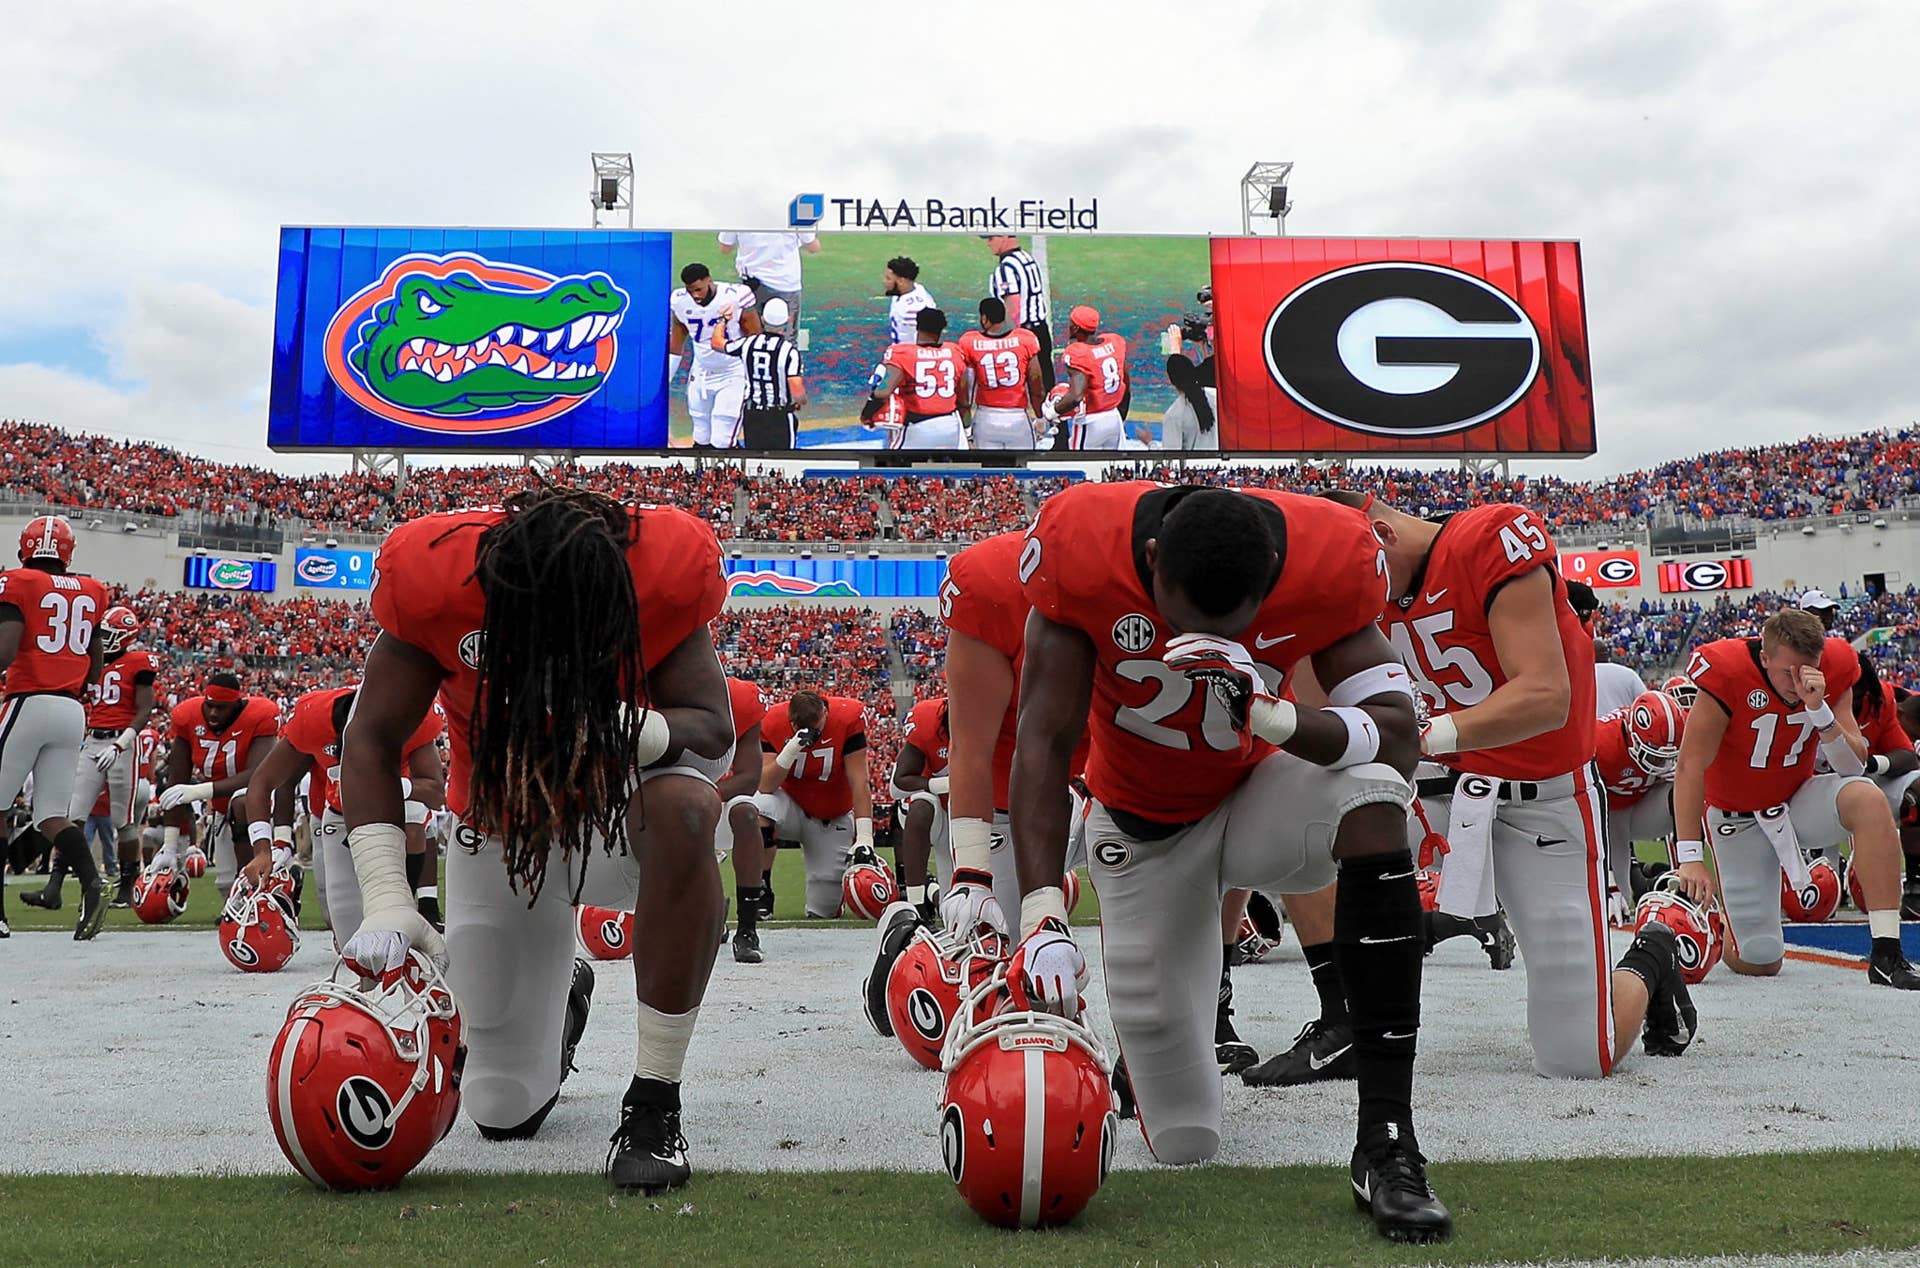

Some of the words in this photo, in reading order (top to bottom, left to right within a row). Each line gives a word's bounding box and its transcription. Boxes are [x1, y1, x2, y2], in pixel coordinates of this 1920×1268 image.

[831, 198, 916, 227] TIAA
[927, 197, 1009, 228] Bank
[1019, 198, 1097, 229] Field
[1264, 262, 1540, 437] G
[915, 360, 956, 399] 53
[980, 351, 1021, 389] 13
[1101, 357, 1121, 395] 8
[36, 538, 58, 550] 36
[1498, 513, 1547, 563] 45
[349, 555, 361, 571] 0
[1574, 557, 1586, 572] 0
[1599, 559, 1635, 582] G
[1683, 562, 1727, 590] G
[340, 576, 347, 585] 3
[37, 592, 96, 655] 36
[1115, 615, 1153, 652] SEC
[1686, 651, 1711, 680] 17
[1749, 690, 1769, 709] SEC
[1634, 705, 1652, 730] G
[1750, 713, 1815, 769] 17
[199, 739, 238, 778] 71
[1460, 776, 1492, 799] G
[1759, 803, 1788, 821] G
[324, 825, 337, 835] G
[454, 822, 488, 852] G
[1716, 823, 1736, 836] G
[1093, 839, 1133, 871] G
[870, 882, 889, 903] G
[600, 919, 625, 948] G
[229, 939, 259, 966] G
[1676, 933, 1702, 971] G
[908, 987, 945, 1041] G
[1015, 1037, 1054, 1047] DAWGS
[336, 1075, 395, 1150] G
